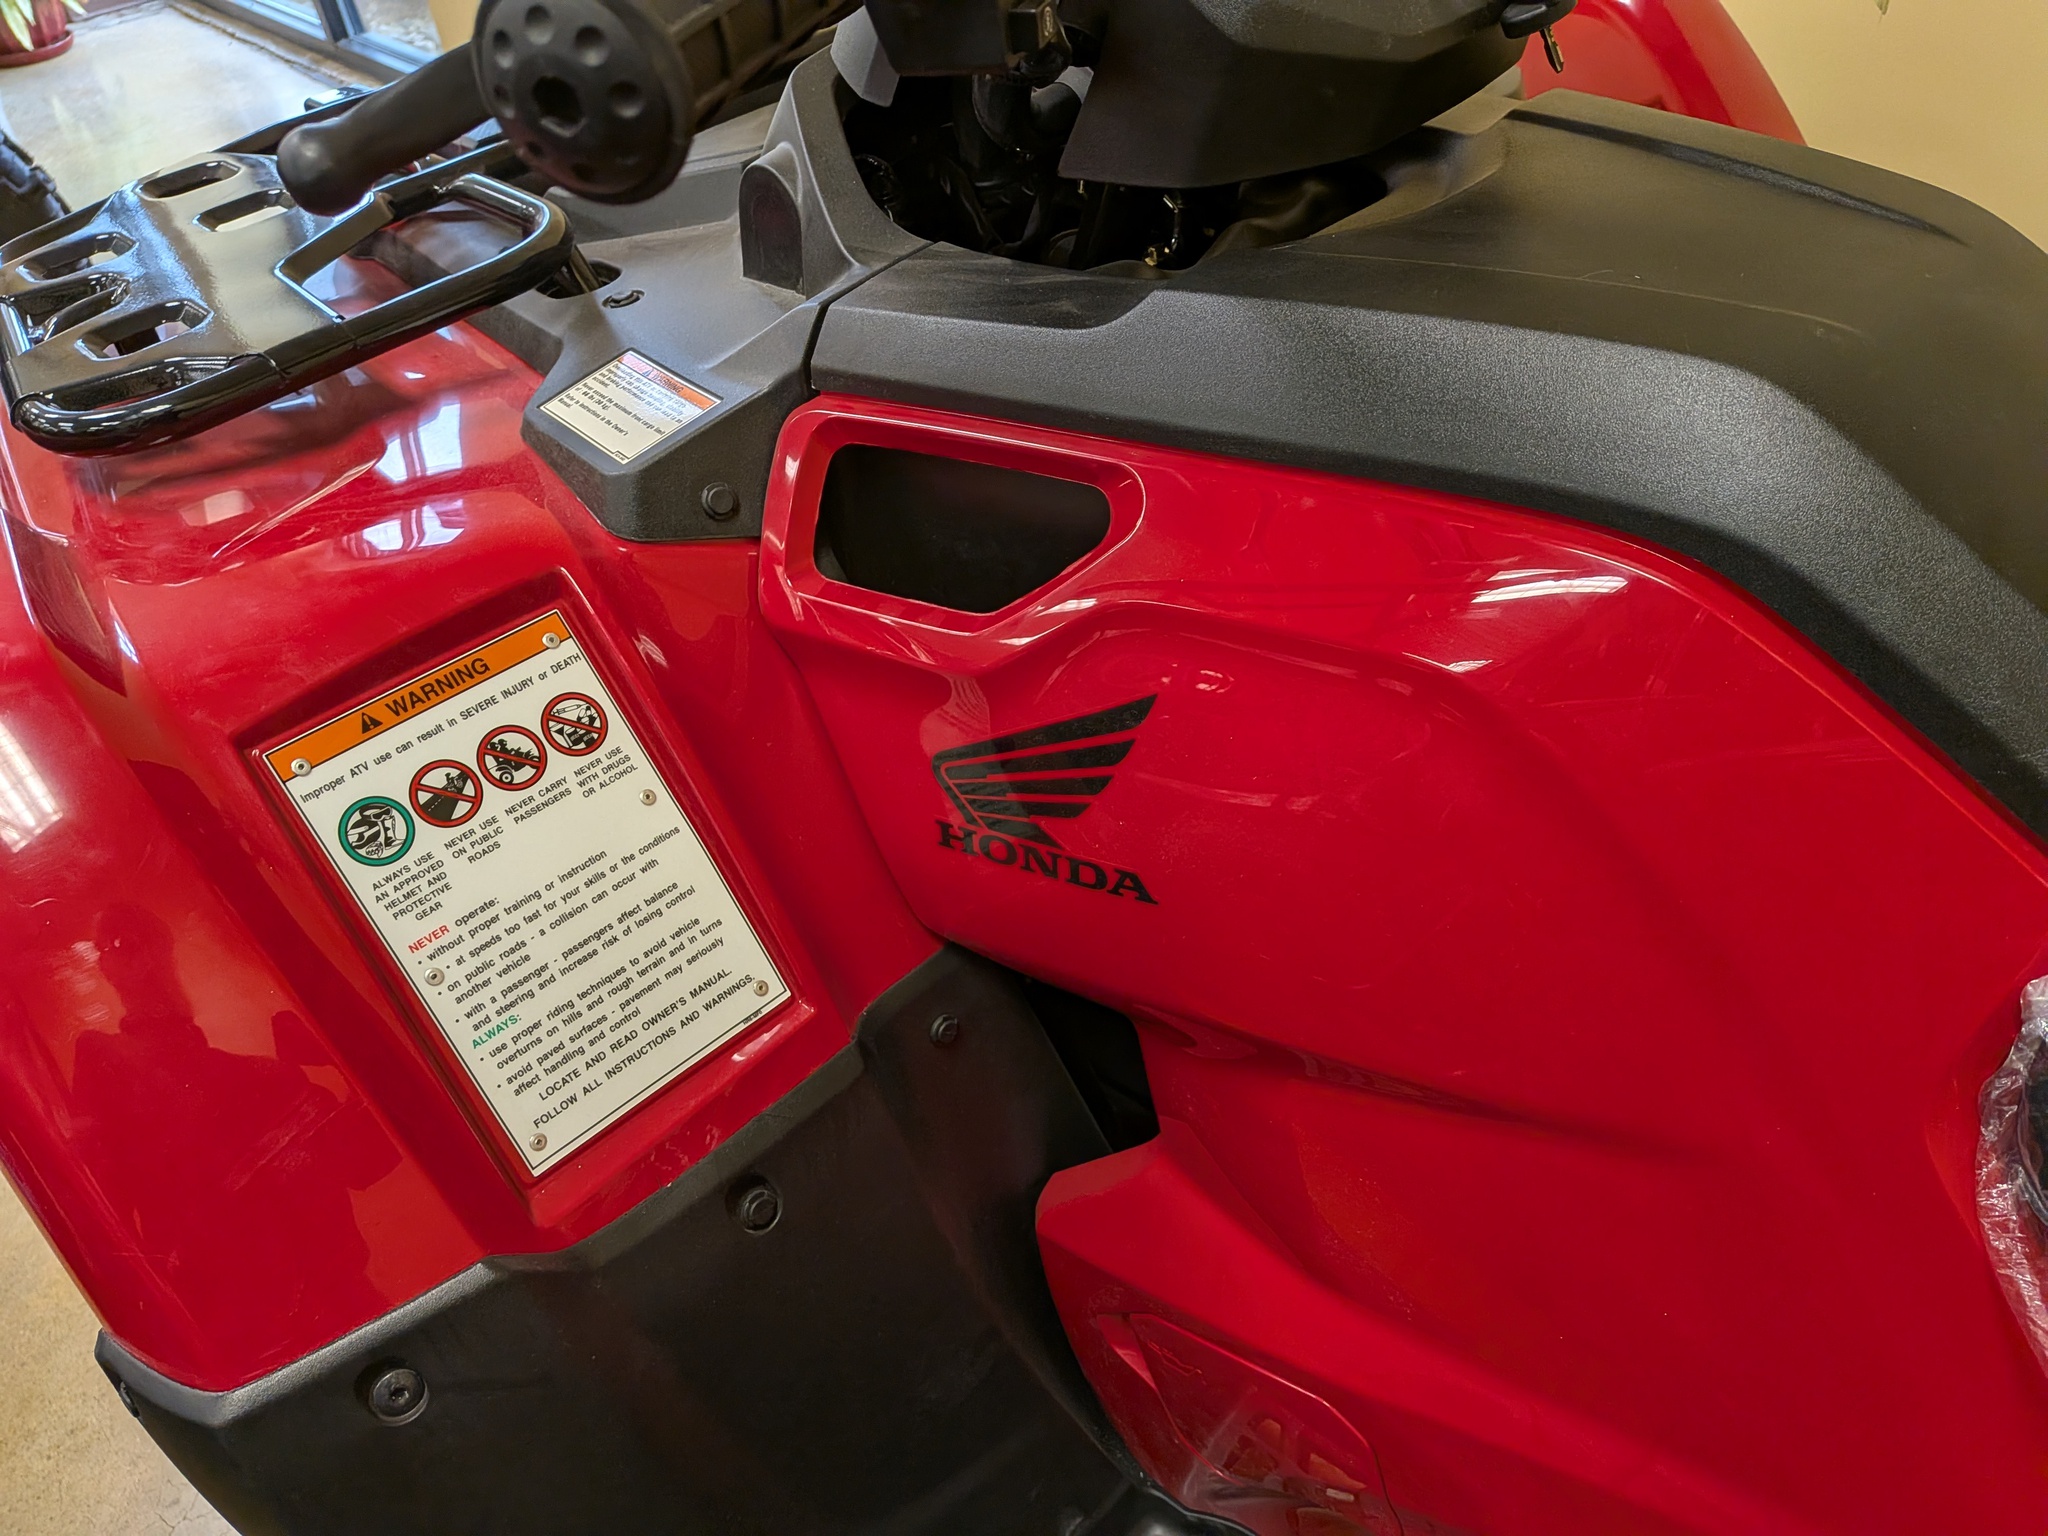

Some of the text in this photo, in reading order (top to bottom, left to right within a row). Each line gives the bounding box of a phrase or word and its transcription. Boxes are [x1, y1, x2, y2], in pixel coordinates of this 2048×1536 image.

[384, 657, 491, 719] WARNING
[299, 652, 581, 803] Improper ATV use can result in SEVERE INJURY or DEATH
[573, 745, 623, 777] NEVER USE
[576, 754, 631, 788] WITH DRUGS
[582, 763, 638, 798] OR ALCOHOL
[504, 775, 567, 816] NEVER CARRY
[513, 787, 572, 824] PASSENGERS
[443, 814, 499, 850] NEVER USE
[451, 825, 504, 859] ON PUBLIC
[467, 840, 501, 864] ROADS
[372, 850, 435, 891] ALWAYS USE
[375, 859, 444, 903] AN APPROVED
[935, 819, 1159, 906] HONDA
[383, 871, 447, 911] HELMET AND
[392, 881, 452, 920] PROTECTIVE
[415, 901, 443, 920] GEAR
[426, 850, 607, 961] without proper training or instruction
[455, 826, 680, 966] at speeds too fast for your skills or the conditions
[407, 897, 499, 953] NEVER operate:
[447, 980, 461, 992] on
[464, 959, 495, 983] public
[498, 939, 527, 960] roads
[538, 928, 546, 936] a
[549, 902, 588, 929] collision
[591, 889, 608, 904] can
[611, 871, 636, 891] occur
[638, 858, 659, 873] with
[463, 1002, 486, 1019] with
[489, 995, 497, 1004] a
[500, 961, 549, 999] passenger
[561, 922, 614, 961] passengers
[616, 903, 642, 924] affect
[643, 882, 678, 907] balance
[454, 953, 531, 1004] another vehicle
[472, 884, 695, 1031] and steering and increase risk of losing control
[488, 918, 700, 1057] use proper riding techniques to avoid vehicle
[496, 918, 722, 1069] overturns on hills and rough terrain and in turns
[505, 1061, 533, 1084] avoid
[536, 1040, 565, 1067] paved
[568, 1014, 608, 1043] surfaces
[618, 977, 662, 1012] pavement
[664, 963, 683, 980] may
[685, 936, 723, 965] seriously
[472, 1013, 522, 1049] ALWAYS:
[513, 1006, 641, 1096] affect handling and control
[533, 1092, 577, 1128] FOLLOW
[582, 1078, 603, 1096] ALL
[604, 1026, 676, 1080] INSTRUCTIONS
[679, 1010, 700, 1029] AND
[701, 974, 755, 1011] WARNINGS.
[538, 968, 732, 1101] LOCATE AND READ OWNER'S MANUAL.
